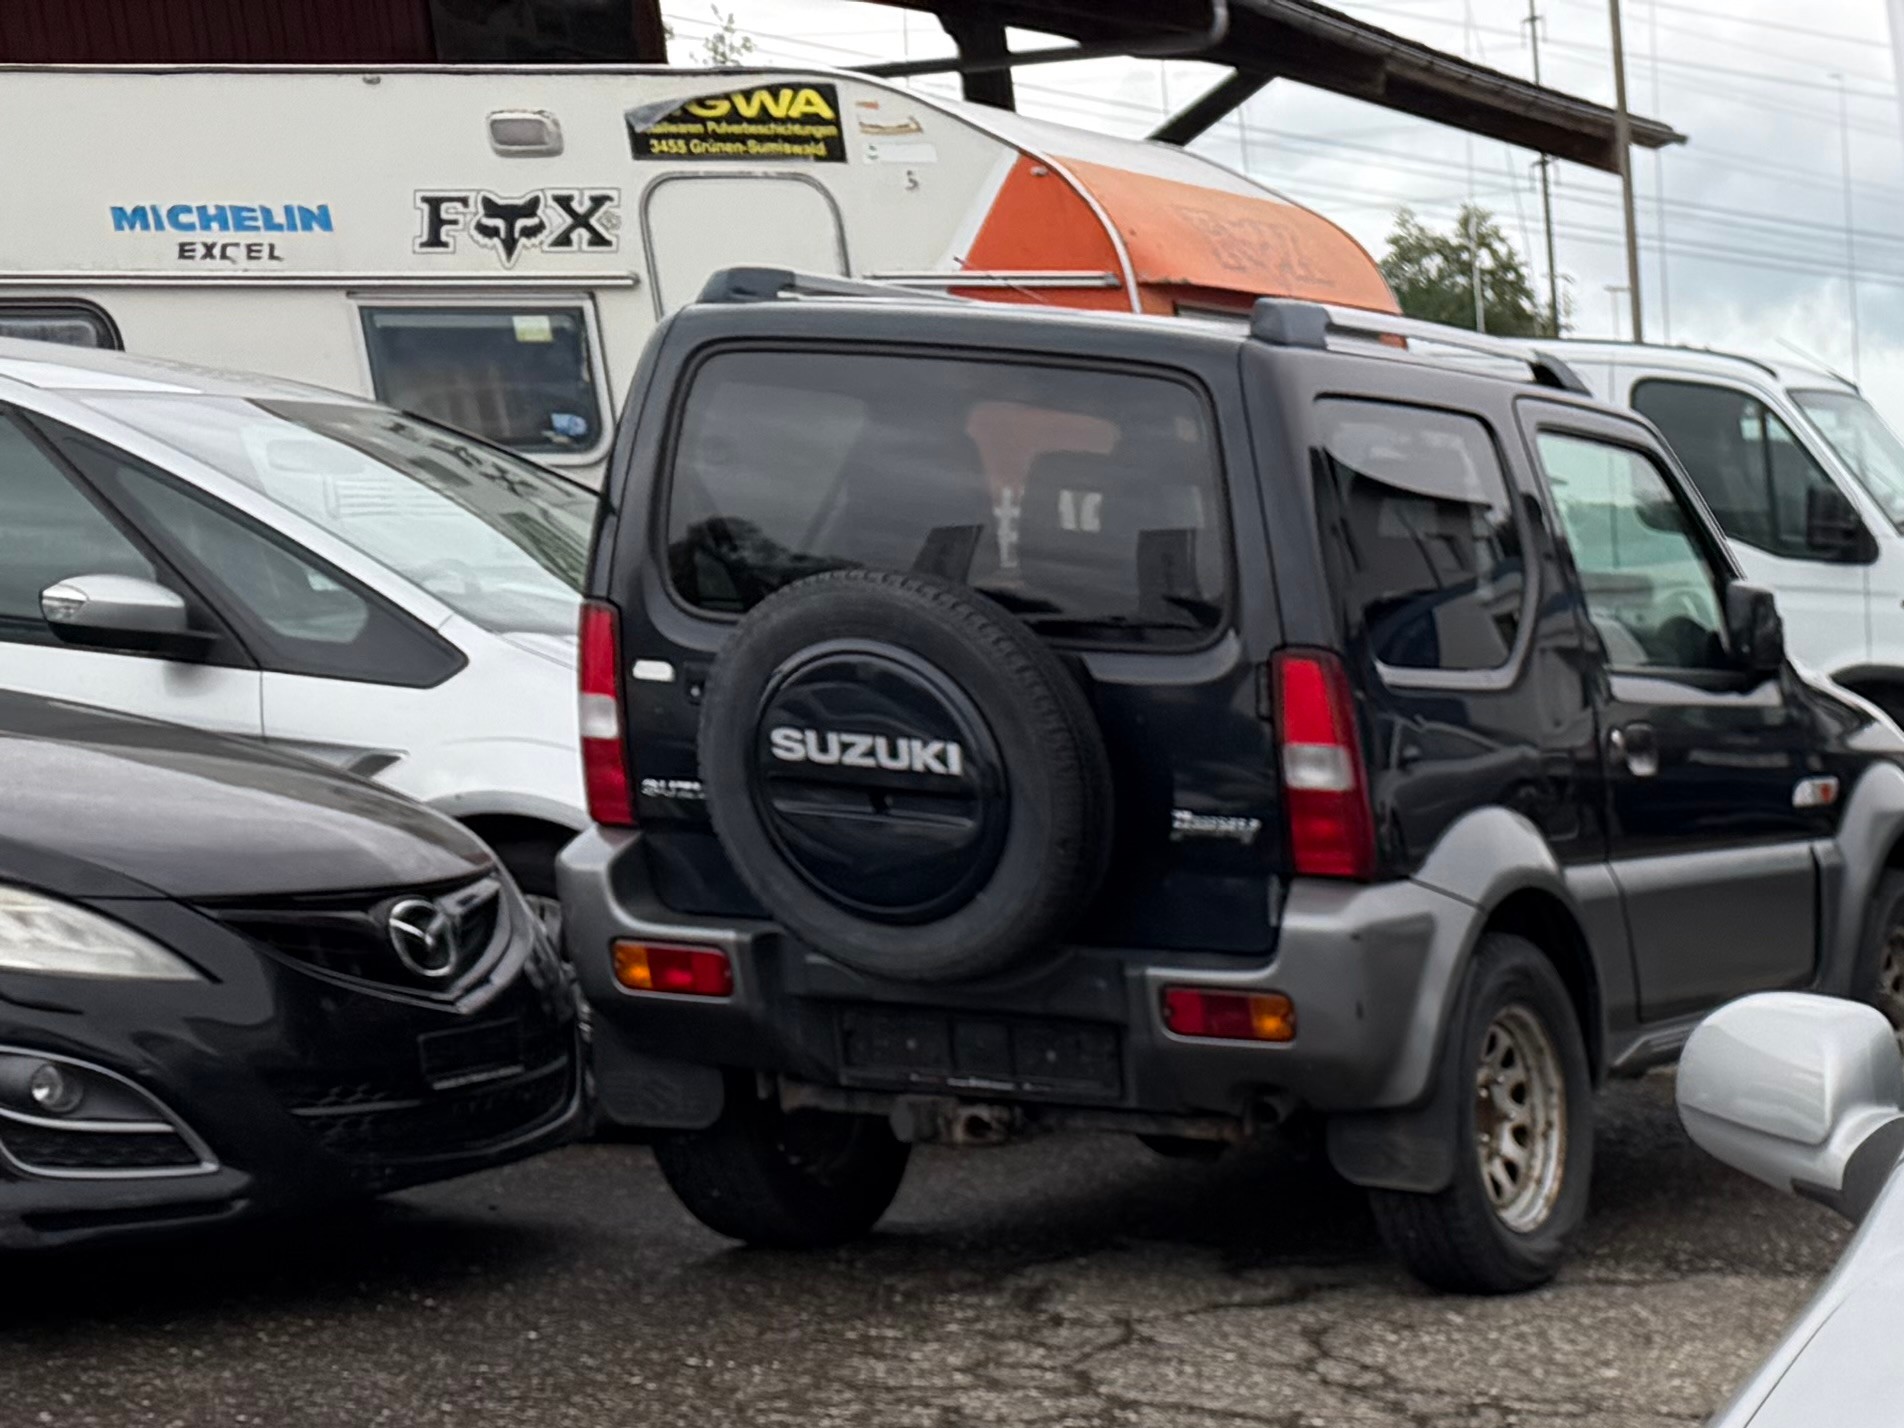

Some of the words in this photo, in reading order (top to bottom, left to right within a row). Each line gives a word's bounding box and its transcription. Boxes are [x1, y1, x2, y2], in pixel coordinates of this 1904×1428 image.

[649, 138, 688, 154] 3455
[110, 204, 333, 232] MICHELIN
[177, 241, 284, 264] EXCEL
[770, 727, 962, 775] SUZUKI
